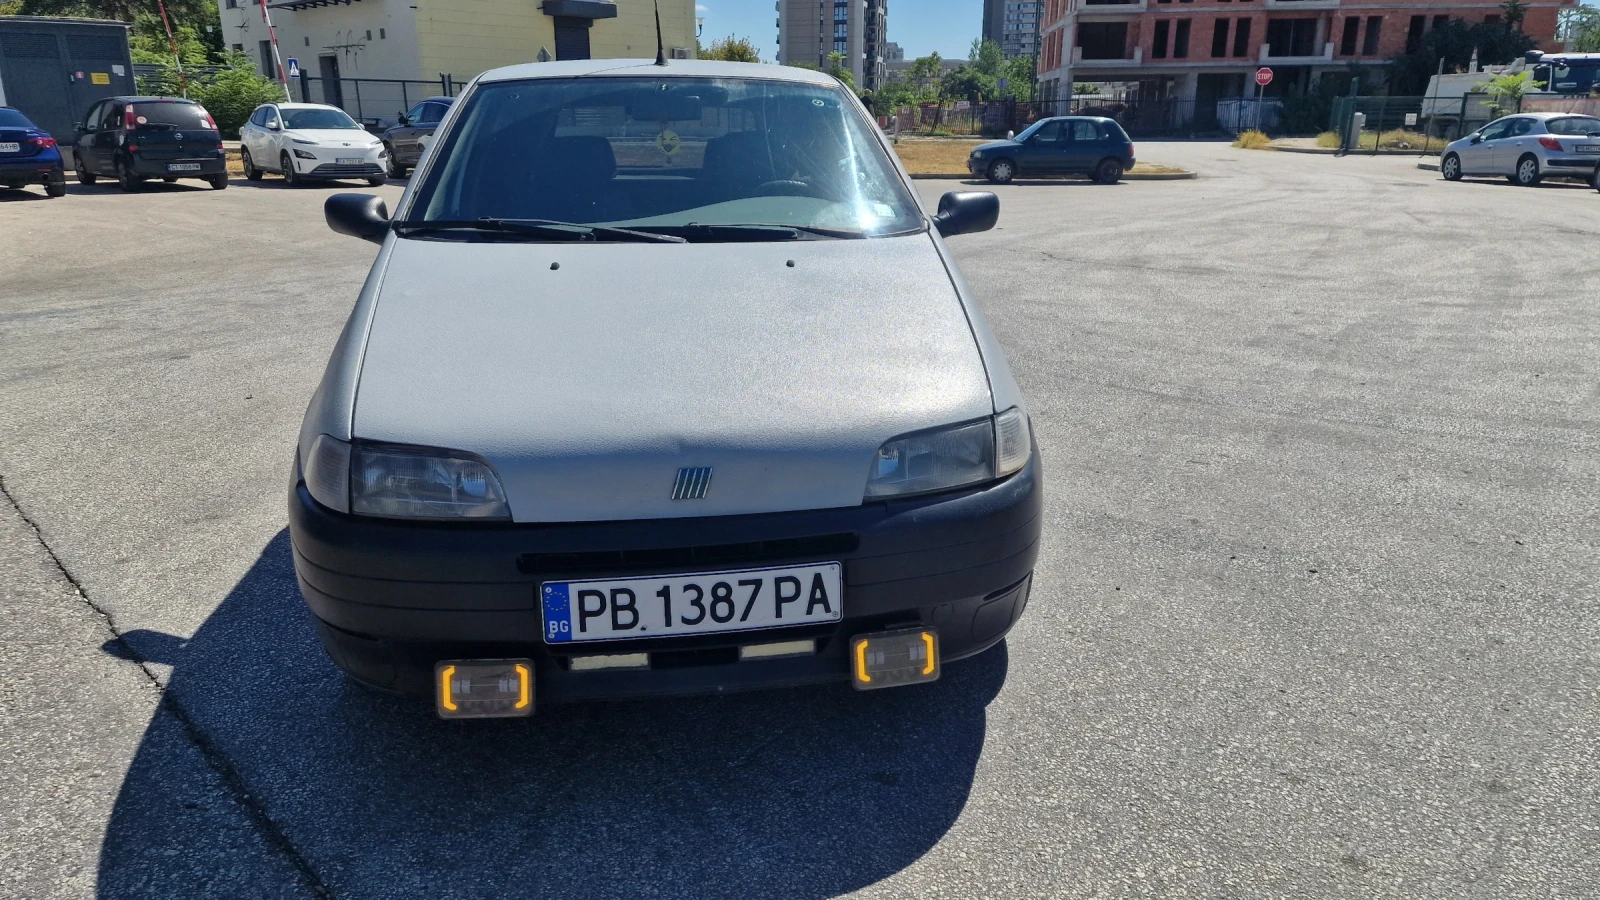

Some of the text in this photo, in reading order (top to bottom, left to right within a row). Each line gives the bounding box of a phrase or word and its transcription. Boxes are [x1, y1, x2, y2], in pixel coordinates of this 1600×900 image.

[577, 573, 832, 632] PB 1387 PA
[549, 620, 569, 633] BG
